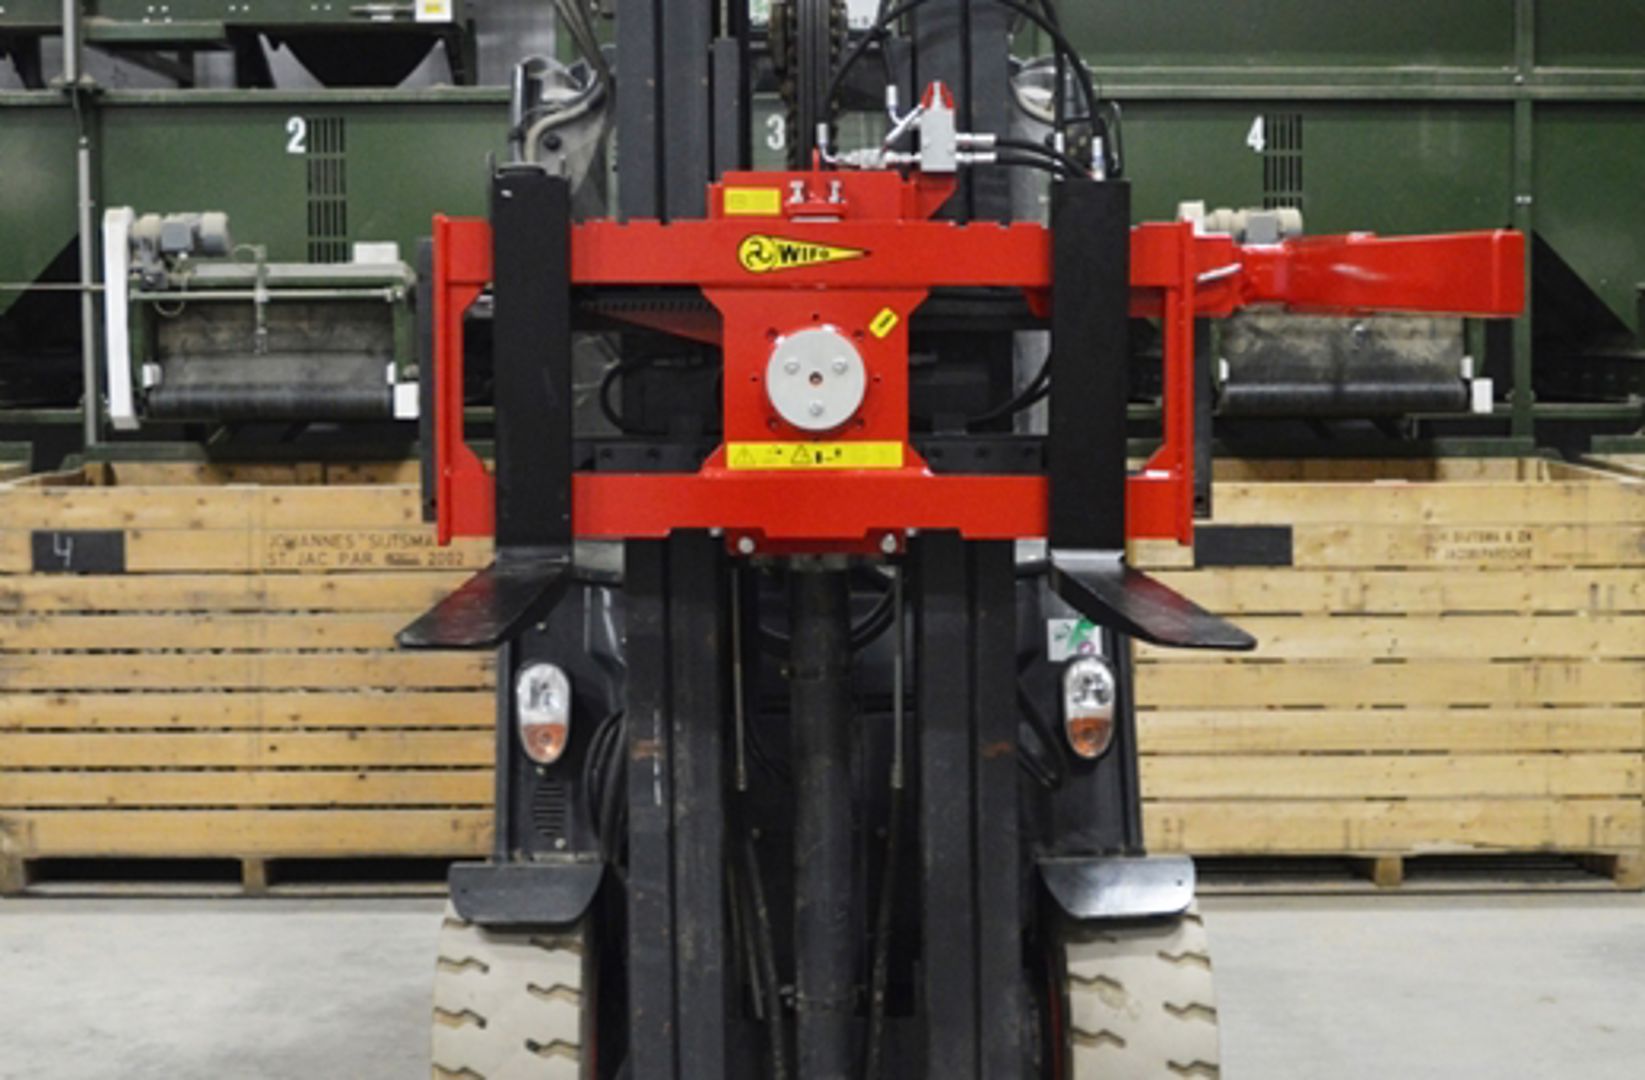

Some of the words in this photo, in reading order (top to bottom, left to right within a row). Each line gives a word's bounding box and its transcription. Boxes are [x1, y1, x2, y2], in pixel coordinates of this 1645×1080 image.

[286, 116, 306, 153] 2
[765, 113, 785, 150] 3
[1246, 115, 1266, 152] 4
[53, 531, 74, 567] 4
